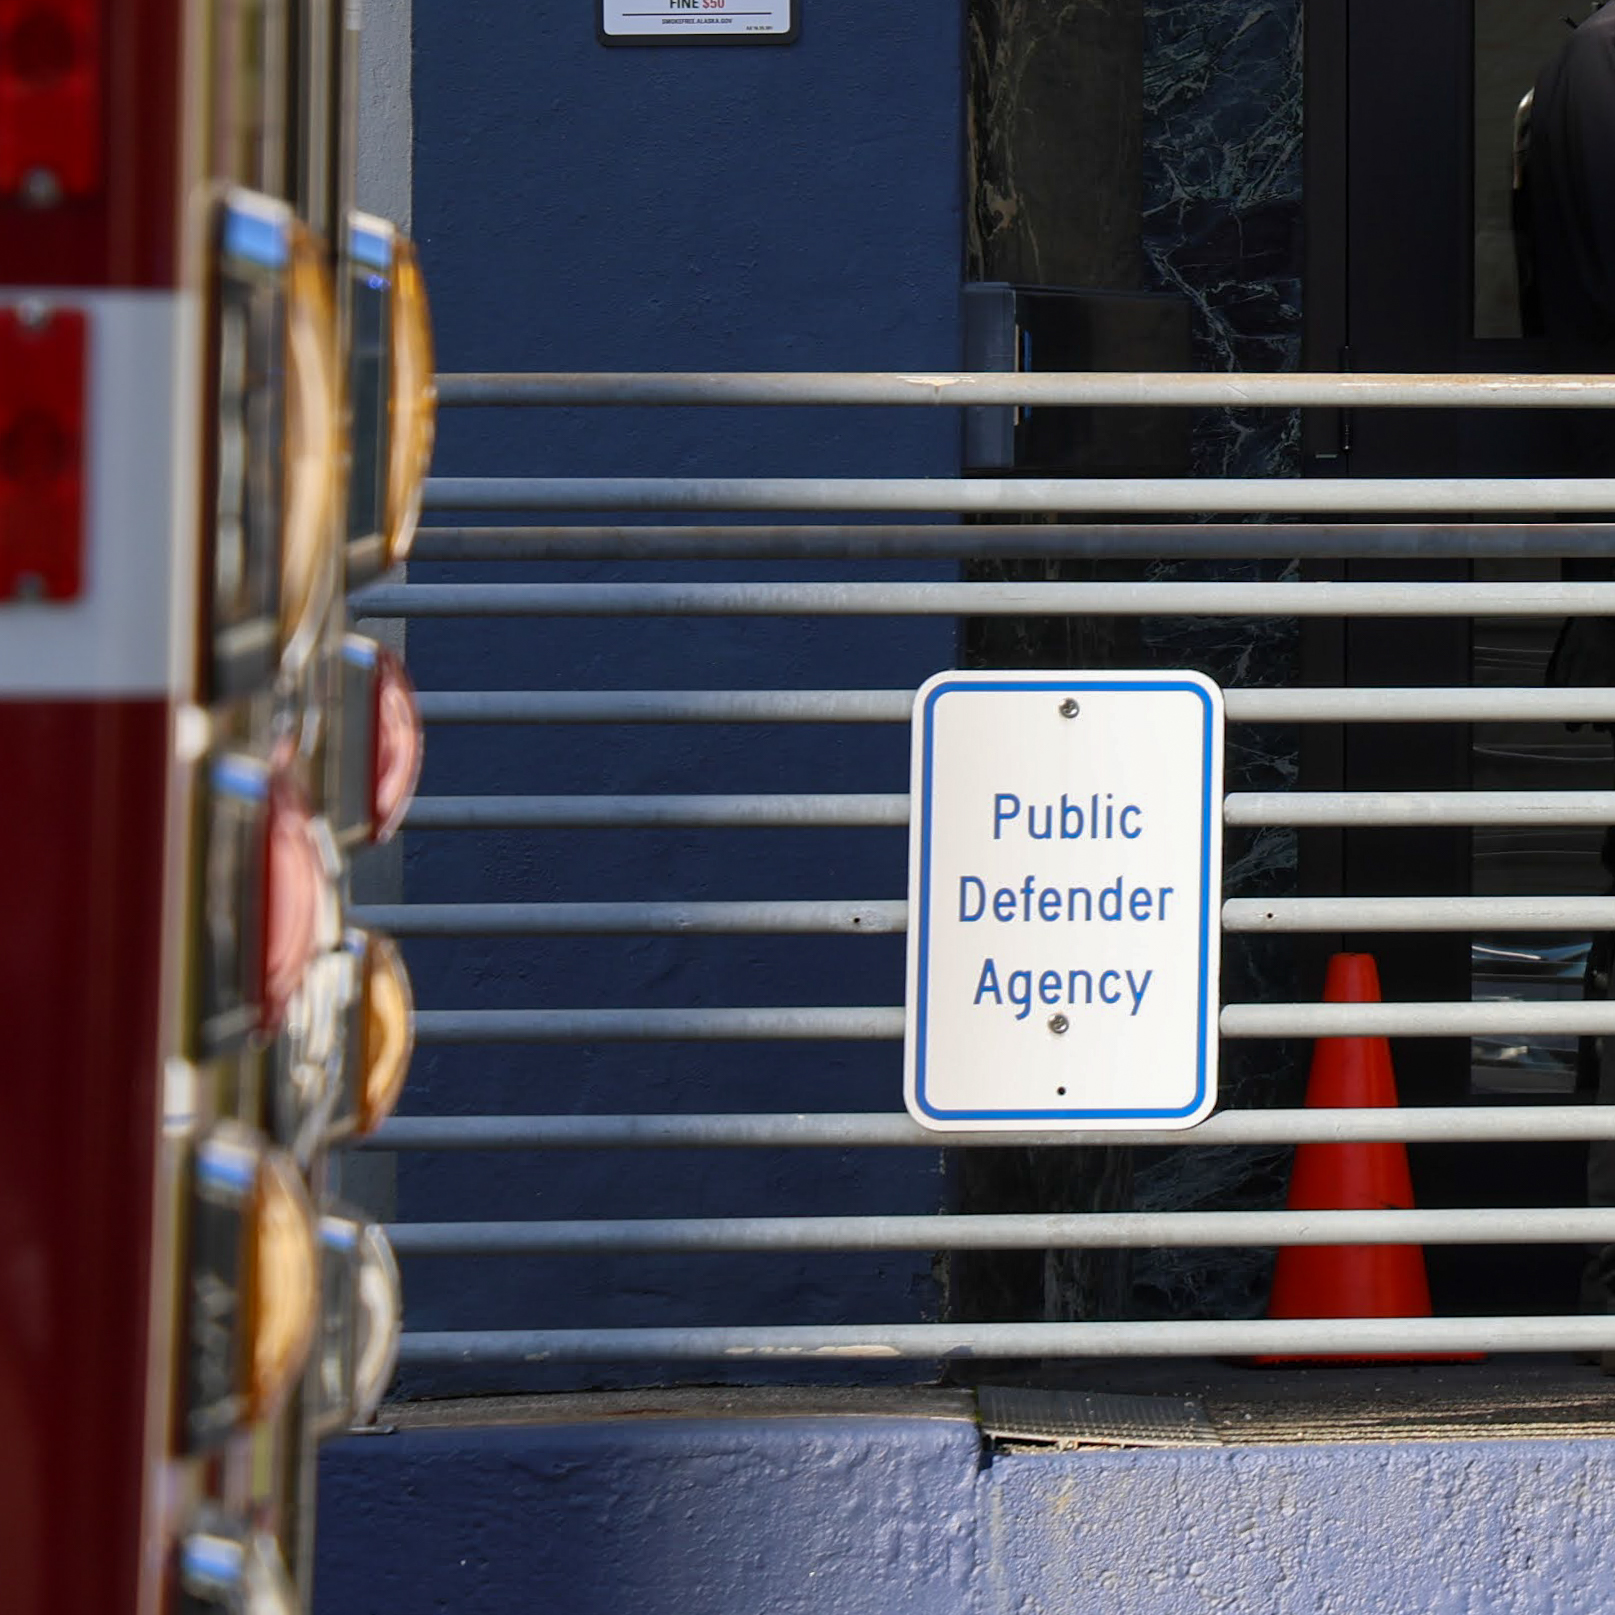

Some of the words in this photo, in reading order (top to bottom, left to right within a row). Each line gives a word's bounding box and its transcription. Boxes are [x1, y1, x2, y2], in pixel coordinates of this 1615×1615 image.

[992, 792, 1142, 840] Public
[959, 875, 1174, 923] Defender
[973, 957, 1153, 1021] Agency
